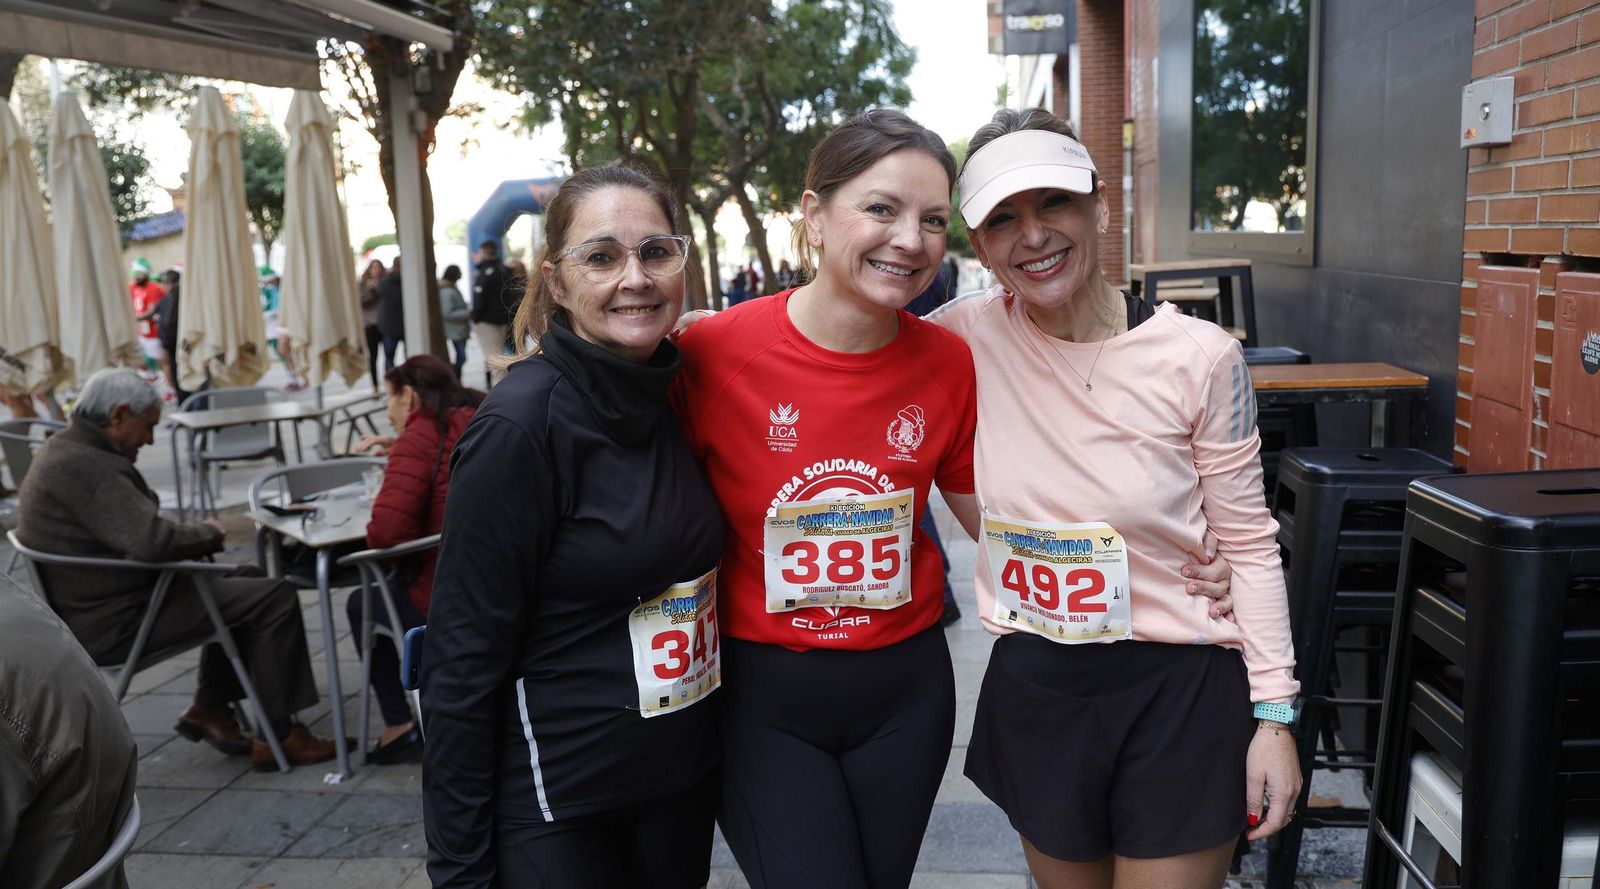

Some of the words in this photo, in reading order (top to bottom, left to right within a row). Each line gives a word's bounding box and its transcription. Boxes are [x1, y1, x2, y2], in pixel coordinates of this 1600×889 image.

[769, 426, 797, 438] UCA
[768, 440, 797, 448] Universidad
[804, 459, 878, 480] SOLIDARIA
[878, 474, 894, 493] DE
[838, 503, 865, 511] EDICIÓN
[797, 511, 850, 529] CARRERA
[850, 508, 894, 528] NAVIDAD
[861, 525, 893, 535] ALGECIRAS
[1004, 531, 1042, 553] CARRERA
[1045, 538, 1092, 556] NAVIDAD
[782, 535, 900, 585] 385
[1054, 556, 1092, 564] ALGECIRAS
[802, 586, 835, 594] RODRIGUEZ
[868, 582, 889, 590] SANDRA
[1002, 559, 1107, 612] 492
[792, 616, 870, 630] CUPRA
[1069, 614, 1088, 622] BELÉN
[652, 607, 718, 680] 347
